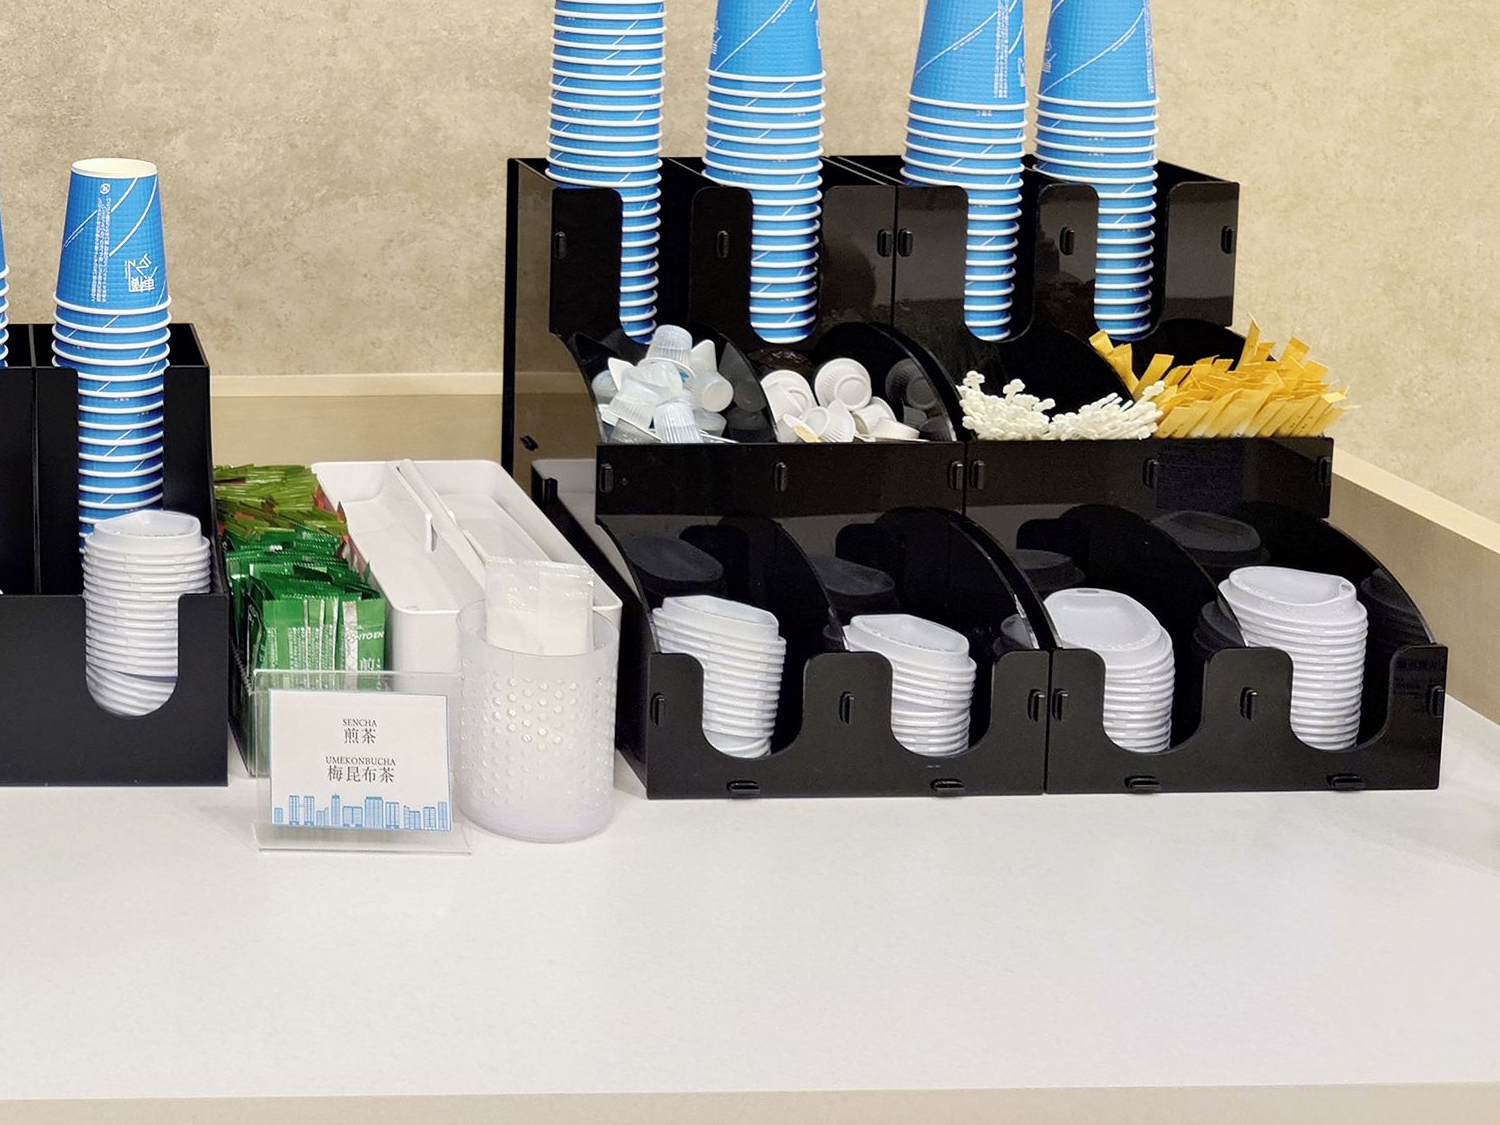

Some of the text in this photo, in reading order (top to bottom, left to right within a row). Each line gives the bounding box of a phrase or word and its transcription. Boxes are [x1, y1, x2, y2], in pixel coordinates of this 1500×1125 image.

[342, 718, 378, 727] SENCHA
[344, 728, 377, 744] 煎茶
[325, 756, 397, 766] UMEKONBUCHA
[328, 765, 396, 783] 梅昆布茶
